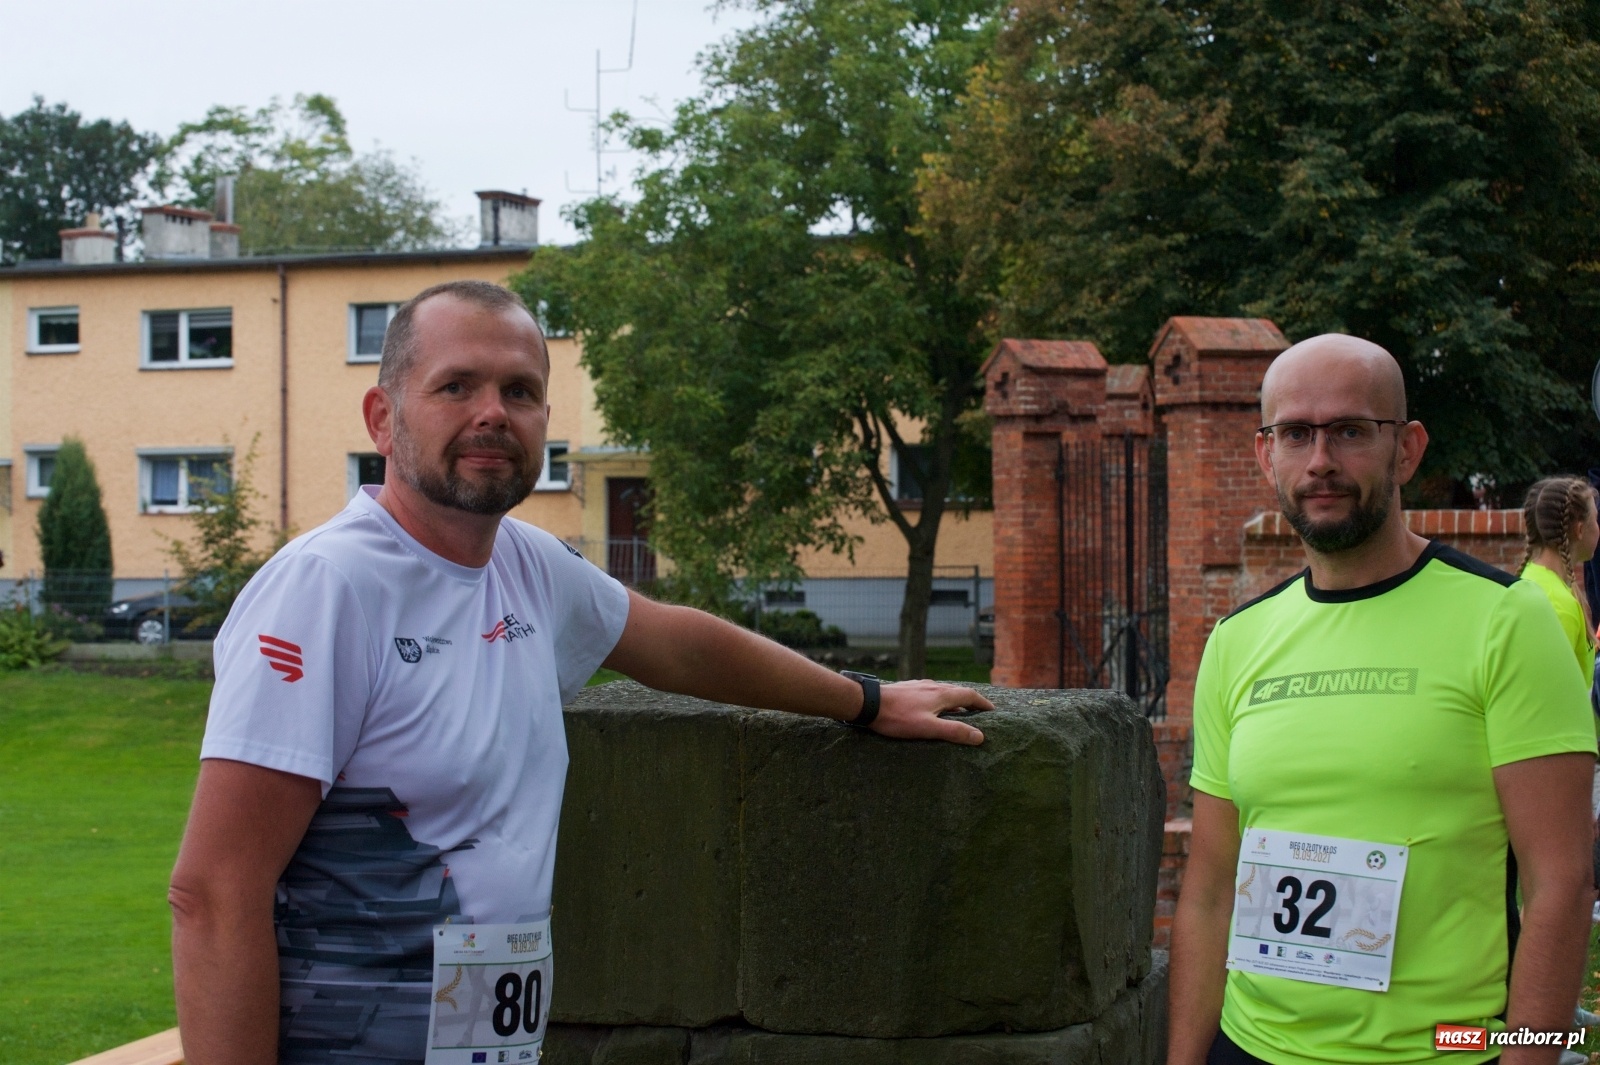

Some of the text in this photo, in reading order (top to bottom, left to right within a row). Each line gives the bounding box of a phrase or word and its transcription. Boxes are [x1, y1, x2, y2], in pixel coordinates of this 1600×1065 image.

[1254, 671, 1410, 700] 4F RUNNING
[1293, 849, 1331, 863] 19.09.2021
[1273, 875, 1337, 938] 32
[492, 969, 541, 1036] 80
